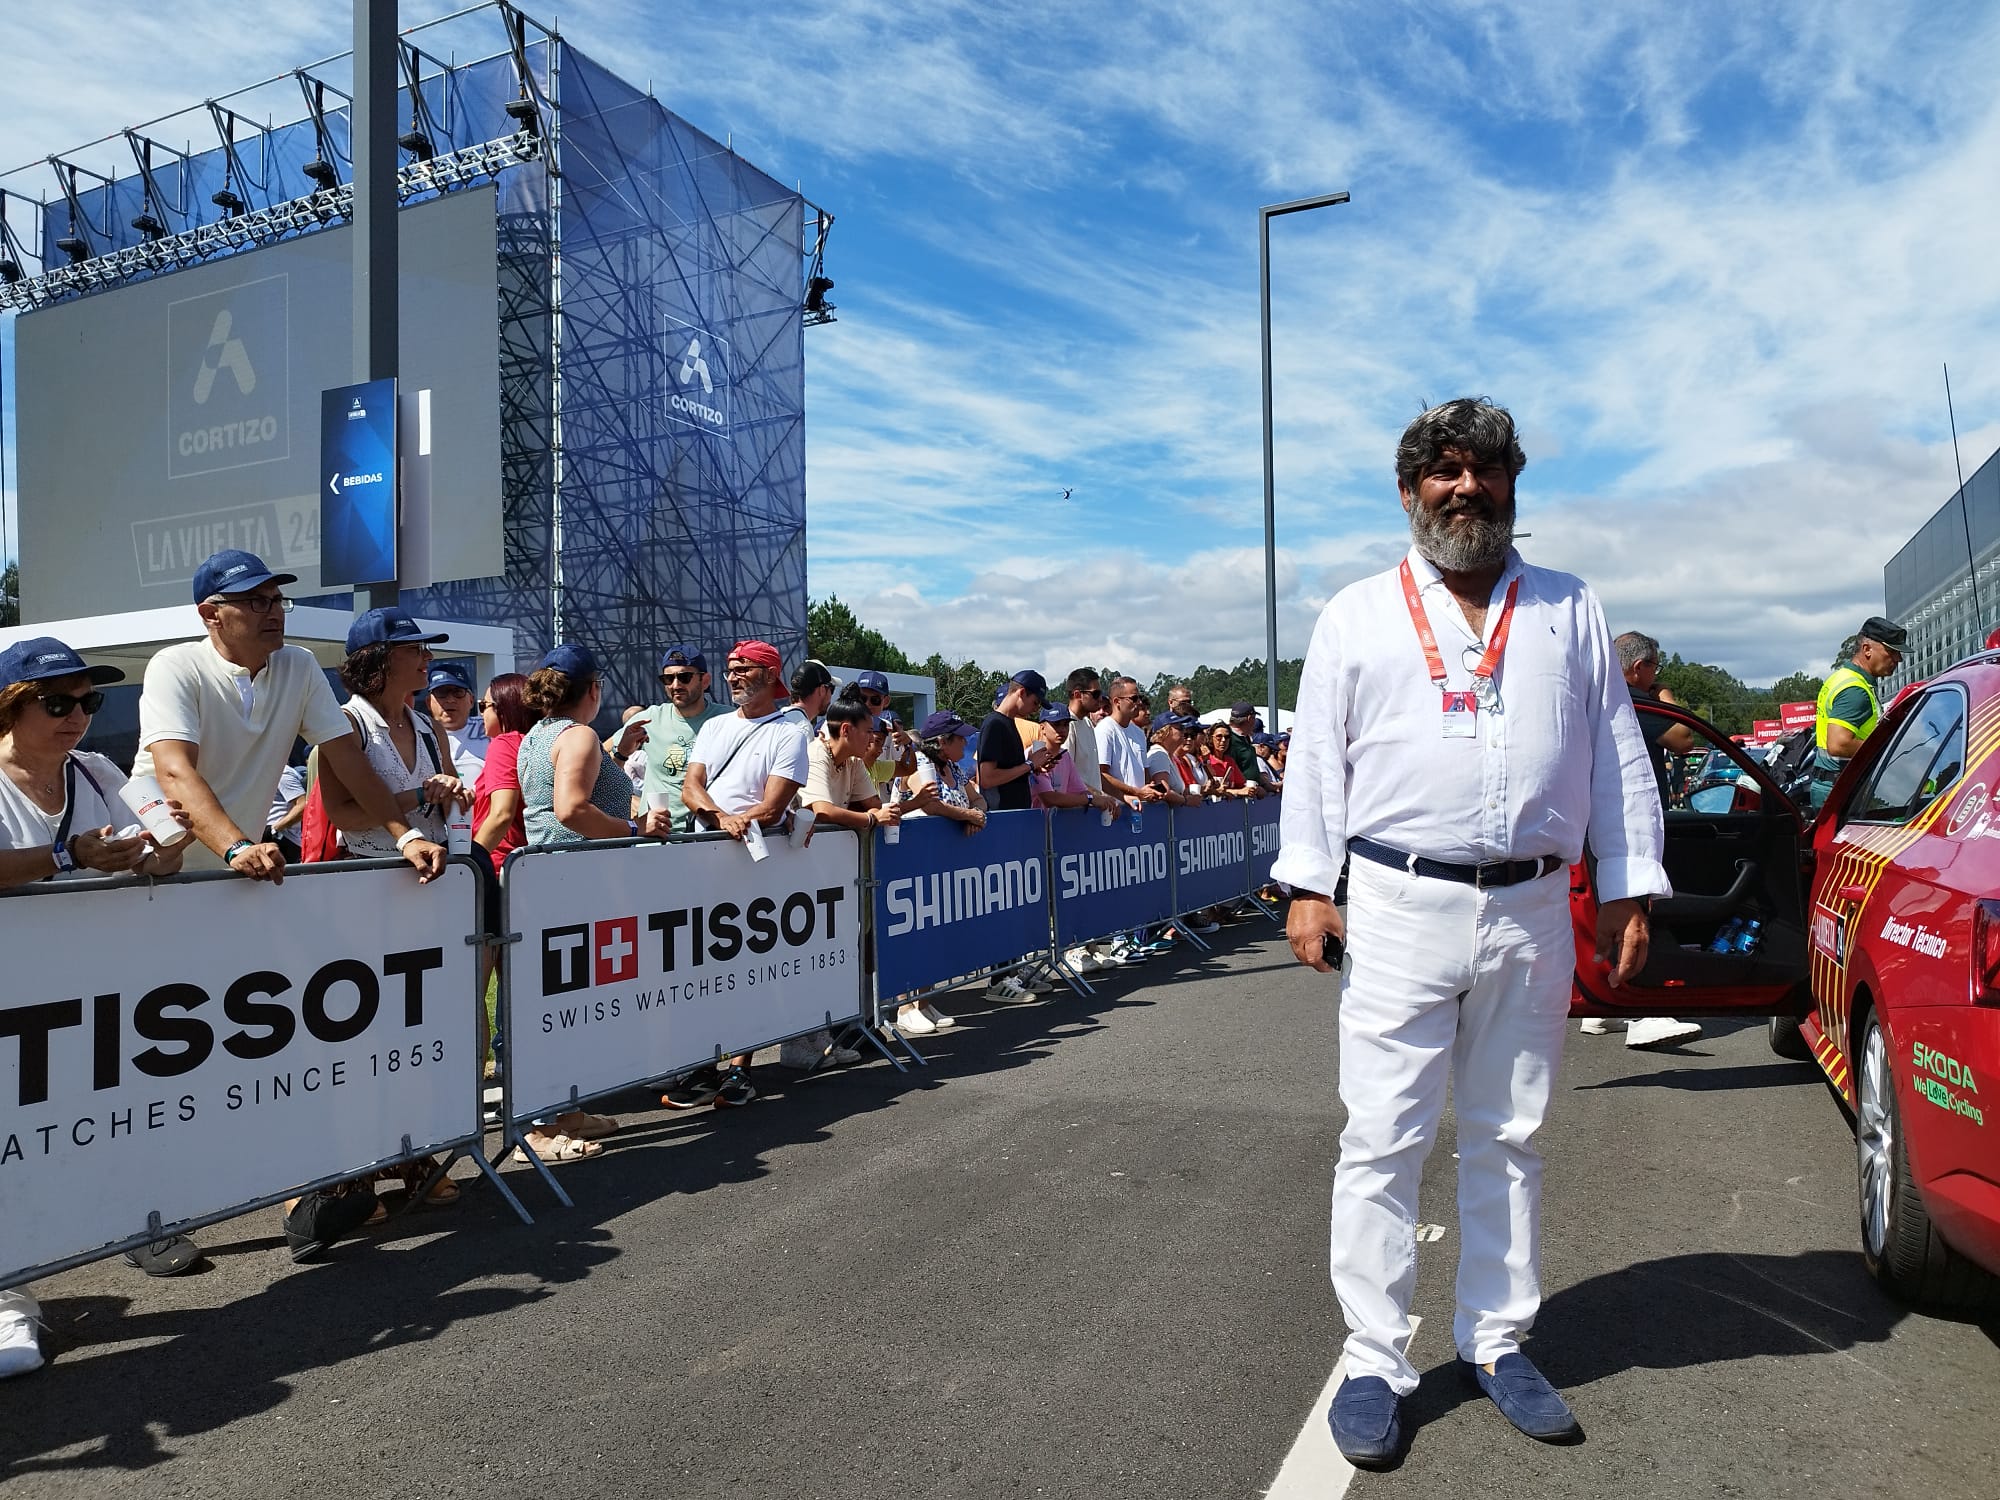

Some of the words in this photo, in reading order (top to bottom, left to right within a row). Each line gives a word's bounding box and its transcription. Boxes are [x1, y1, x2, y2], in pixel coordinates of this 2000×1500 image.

[671, 394, 723, 425] CORTIZO
[178, 415, 278, 457] CORTIZO
[343, 472, 383, 488] BEBIDAS
[289, 509, 320, 553] 24
[1060, 842, 1167, 900] SHIMANO
[1178, 830, 1245, 876] SHIMANO
[886, 857, 1042, 937] SHIMANO
[648, 886, 844, 973] TISSOT
[1880, 915, 1915, 947] Director
[1911, 924, 1947, 959] Técnico
[542, 998, 621, 1033] SWISS
[636, 973, 736, 1011] WATCHES
[748, 958, 801, 986] SINCE
[811, 949, 846, 971] 1853
[0, 946, 443, 1107] TISSOT
[226, 1061, 347, 1110] SINCE
[370, 1040, 445, 1078] 1853
[1948, 1092, 1984, 1126] Cycling
